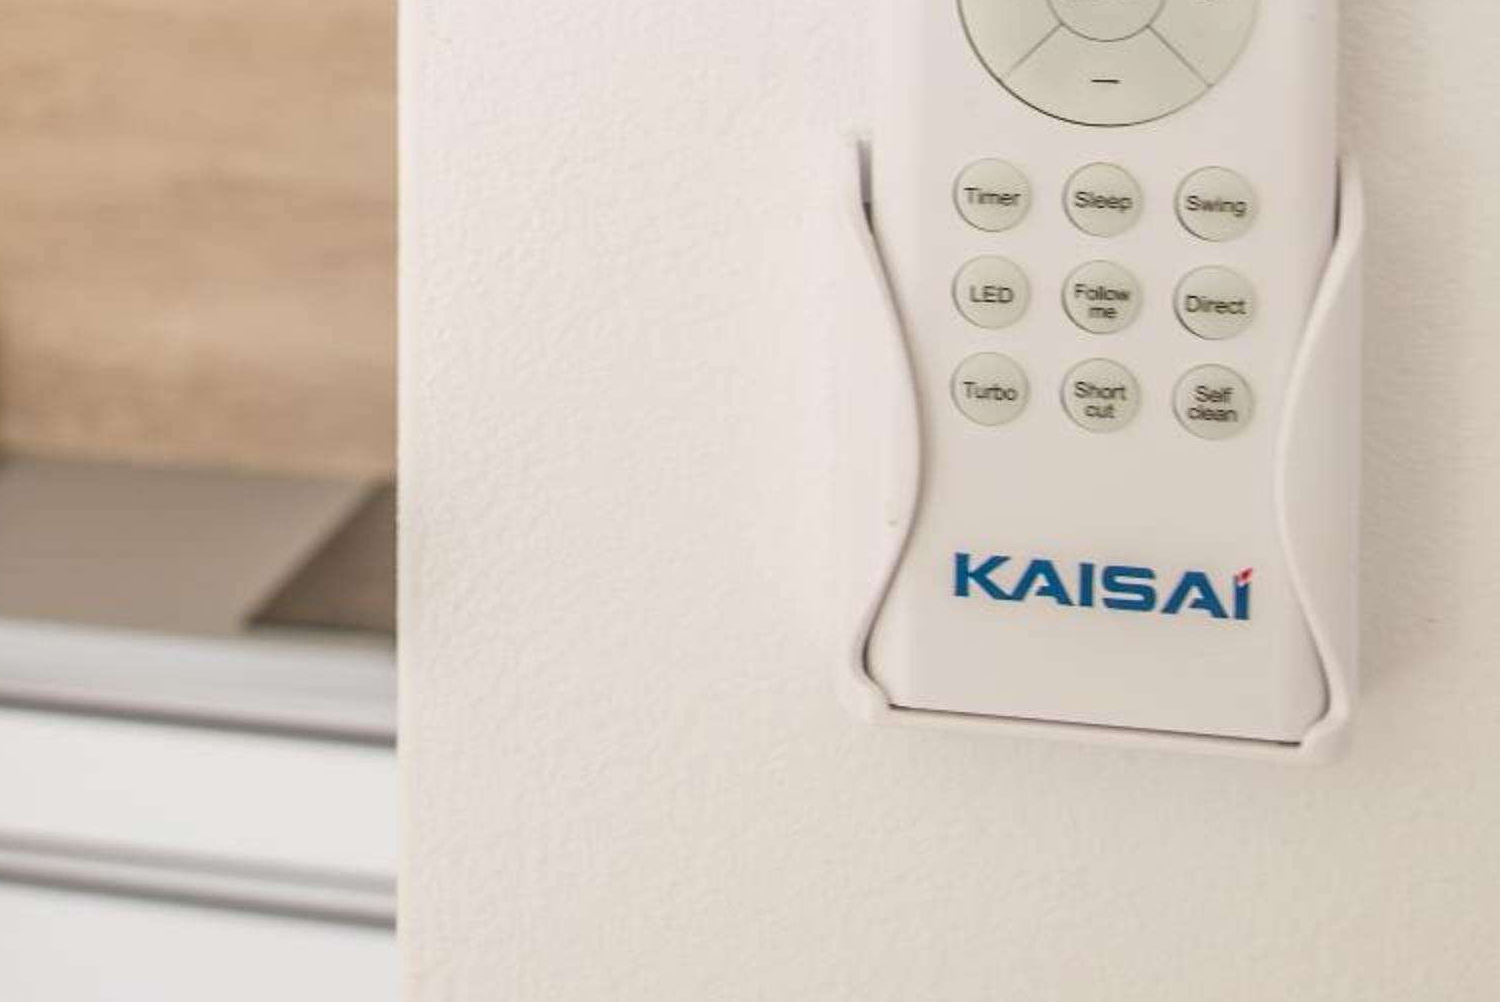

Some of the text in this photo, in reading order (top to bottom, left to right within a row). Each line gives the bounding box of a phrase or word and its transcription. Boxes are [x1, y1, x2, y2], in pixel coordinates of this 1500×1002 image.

[963, 187, 1021, 206] Timer
[1074, 191, 1133, 213] Sleep
[1186, 195, 1247, 217] Swing
[969, 285, 1015, 304] LED
[1074, 283, 1131, 301] Follow
[1088, 306, 1117, 319] me
[1185, 295, 1247, 315] Direct
[963, 381, 1019, 401] Turbo
[1073, 381, 1127, 401] Short
[1194, 385, 1234, 403] Self
[1084, 404, 1115, 419] cut
[1187, 406, 1238, 422] clean
